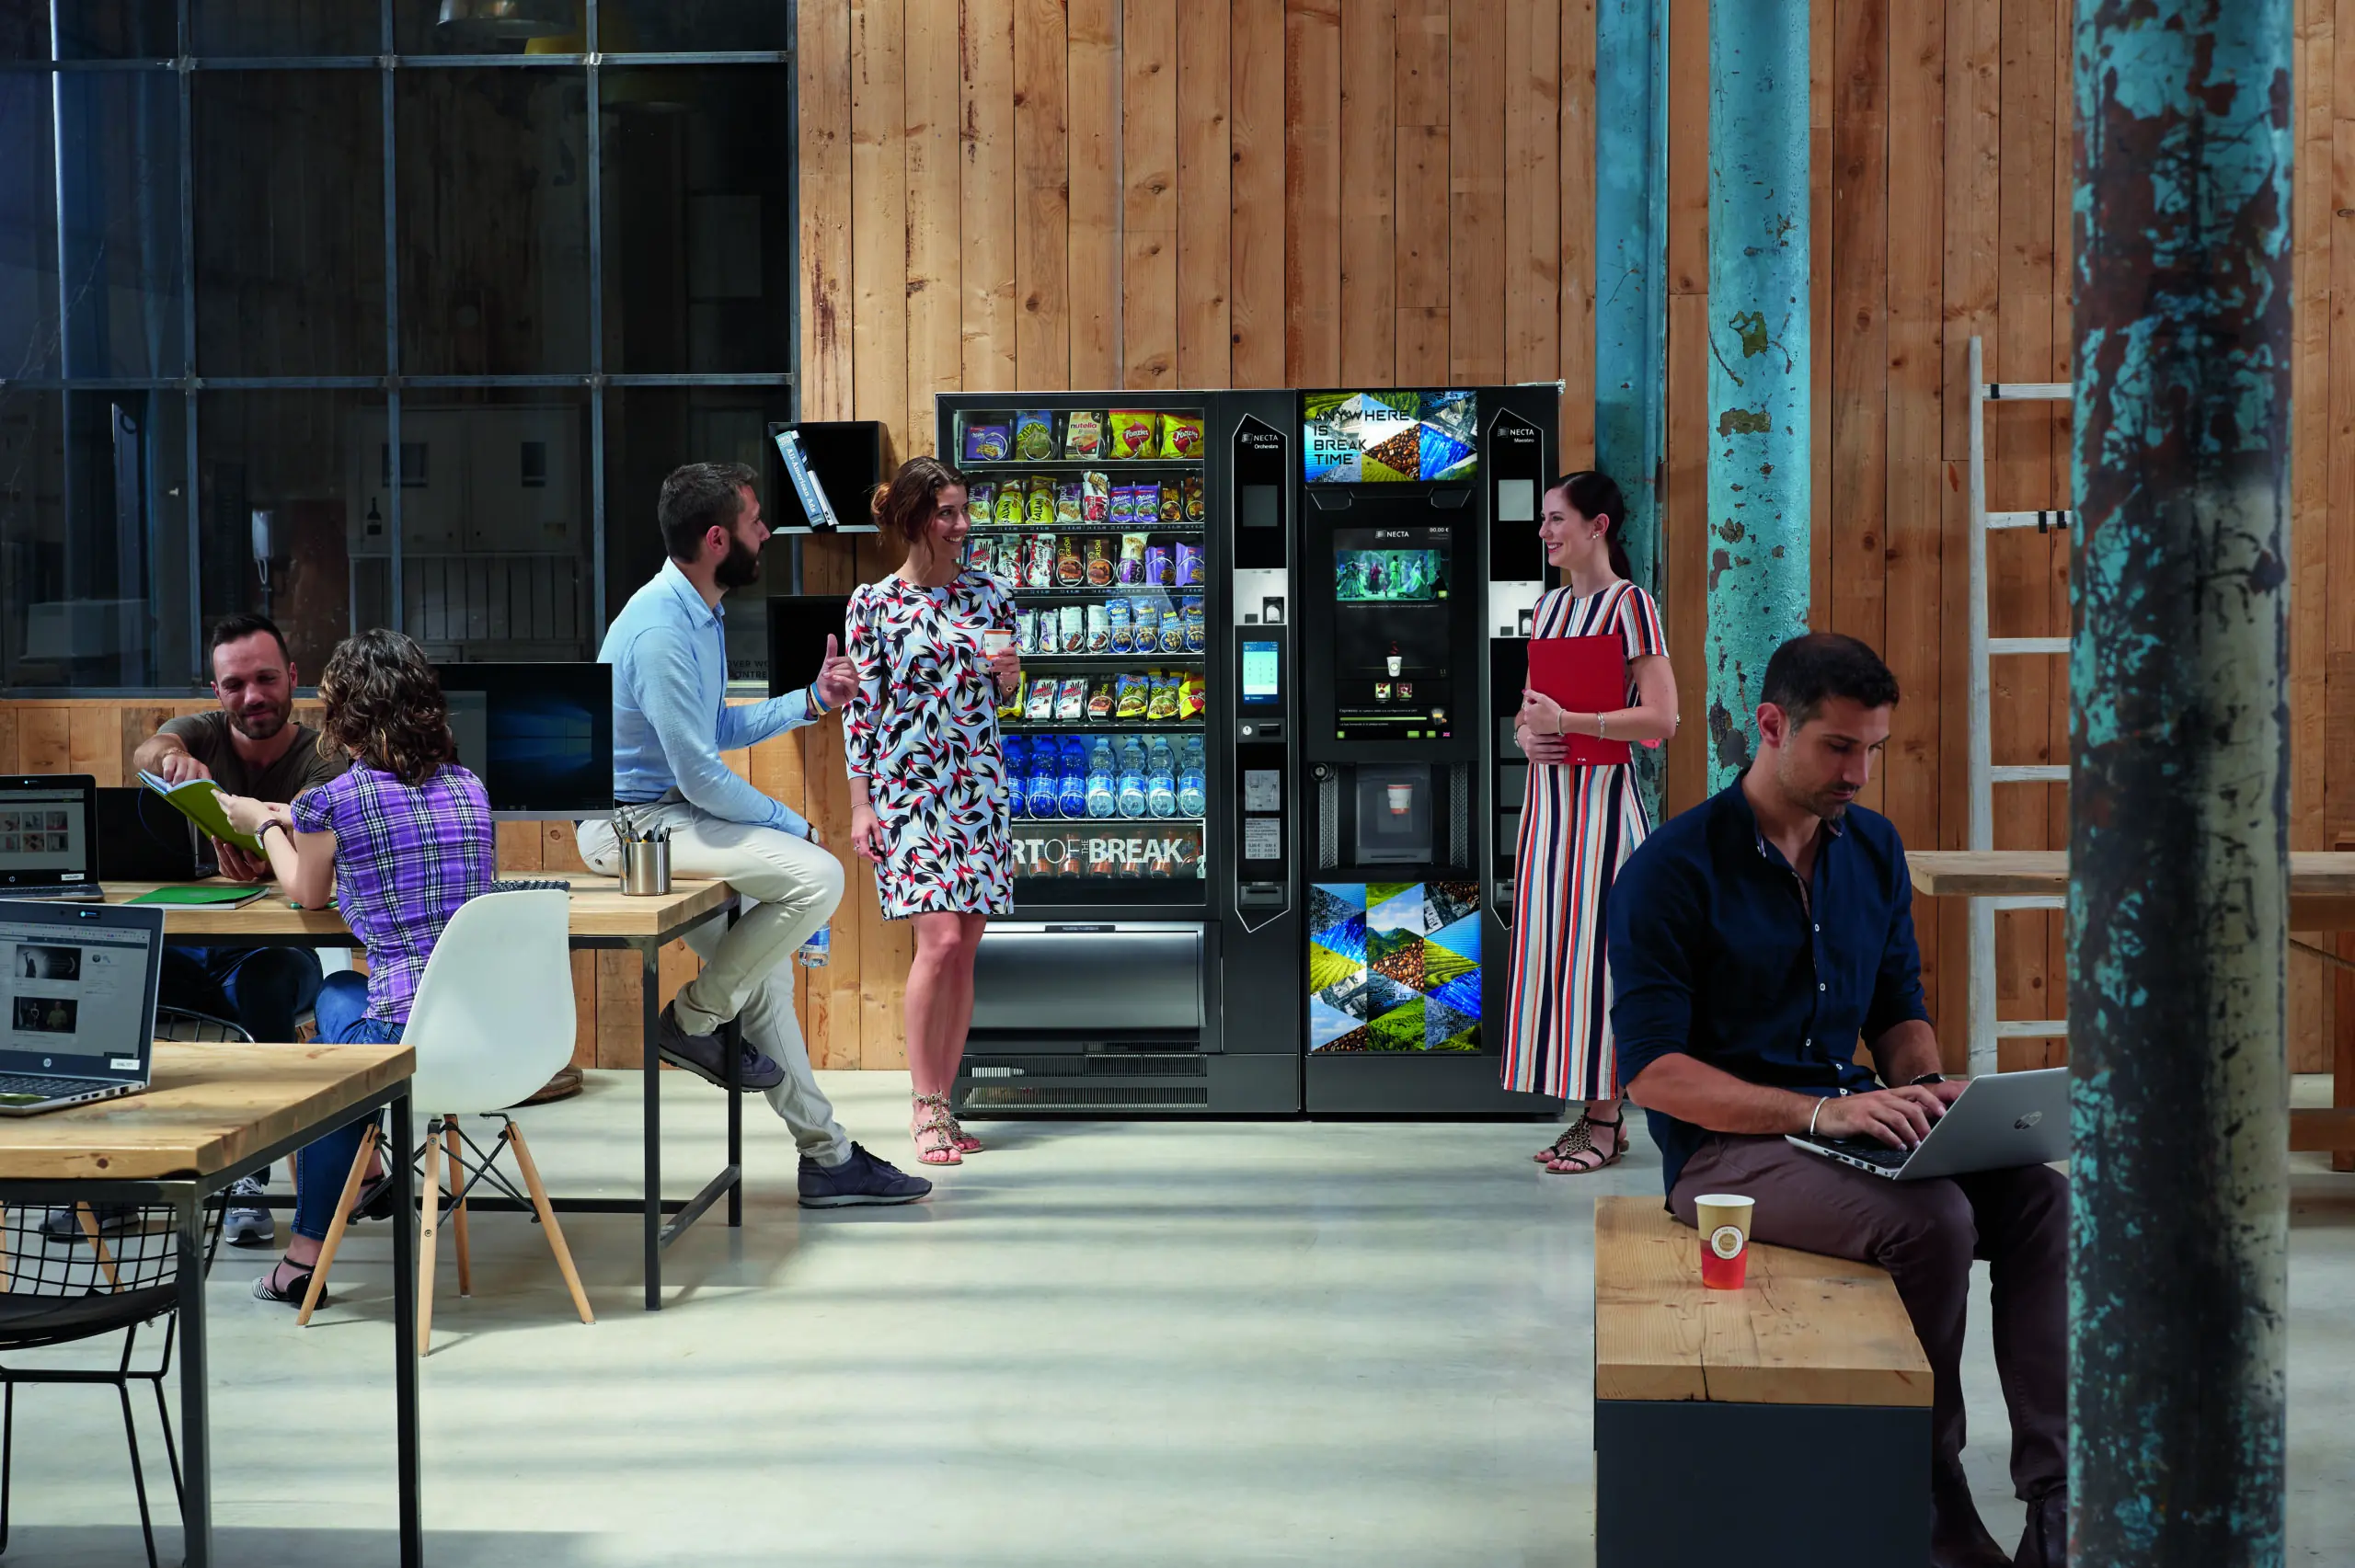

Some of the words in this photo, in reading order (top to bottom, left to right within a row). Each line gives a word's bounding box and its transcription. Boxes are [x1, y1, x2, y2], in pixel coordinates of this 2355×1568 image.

[1314, 409, 1409, 422] ANYWHERE
[1314, 426, 1328, 437] IS
[1315, 439, 1368, 451] BREAK
[1315, 453, 1354, 465] TIME
[787, 448, 810, 498] All-American
[806, 498, 817, 513] Ads
[1081, 839, 1089, 855] THE
[1089, 839, 1184, 864] BREAK
